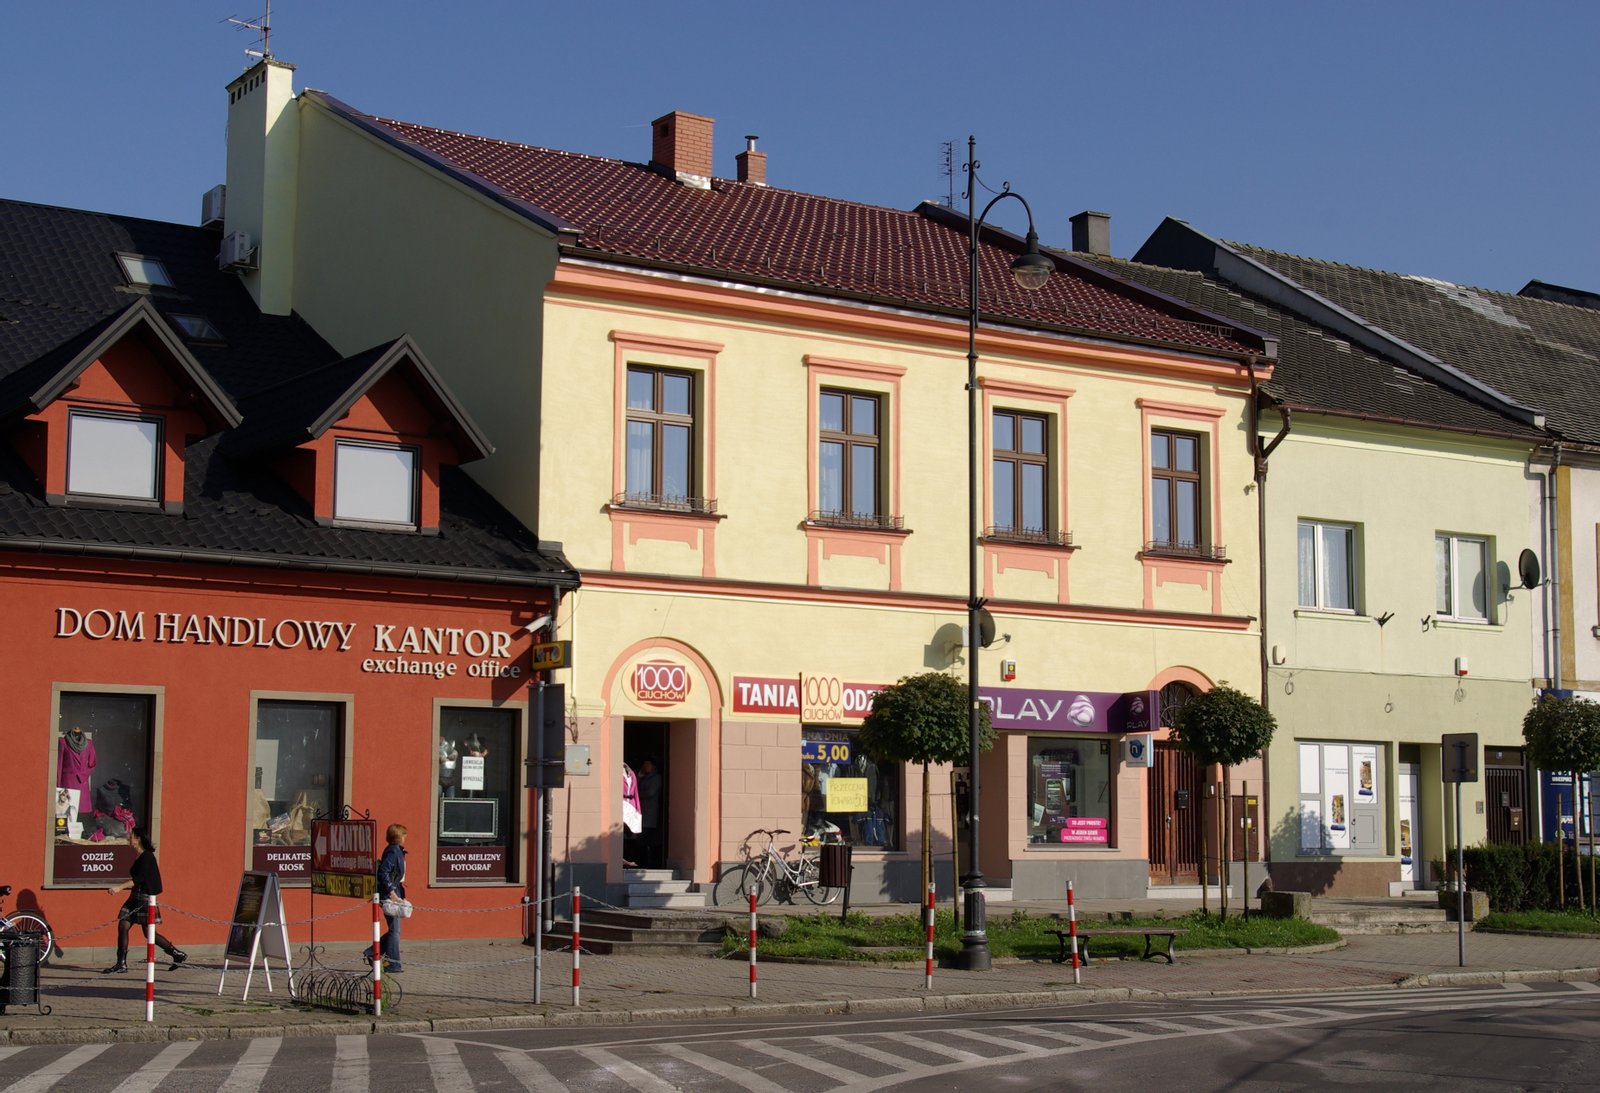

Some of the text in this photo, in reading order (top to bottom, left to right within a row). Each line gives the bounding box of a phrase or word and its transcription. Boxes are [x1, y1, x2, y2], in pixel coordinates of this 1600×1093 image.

[56, 607, 356, 650] DOM HANDLOWY
[374, 624, 512, 658] KANTOR
[362, 656, 521, 679] exchange office
[637, 665, 685, 690] 1000
[638, 689, 685, 701] CIUCHÓW
[738, 682, 799, 708] TANIA
[803, 676, 841, 706] 1000
[803, 708, 842, 720] CIUCHÓW
[1126, 720, 1149, 729] PLAY
[817, 744, 849, 763] 5,00
[331, 825, 372, 852] KANTOR
[81, 851, 114, 861] ODZIEŻ
[267, 853, 311, 861] DELIKATES
[441, 853, 501, 862] SALON BIELIZNY
[82, 864, 113, 872] TABOO
[279, 863, 304, 871] KIOSK
[451, 863, 492, 871] FOTOGRAF
